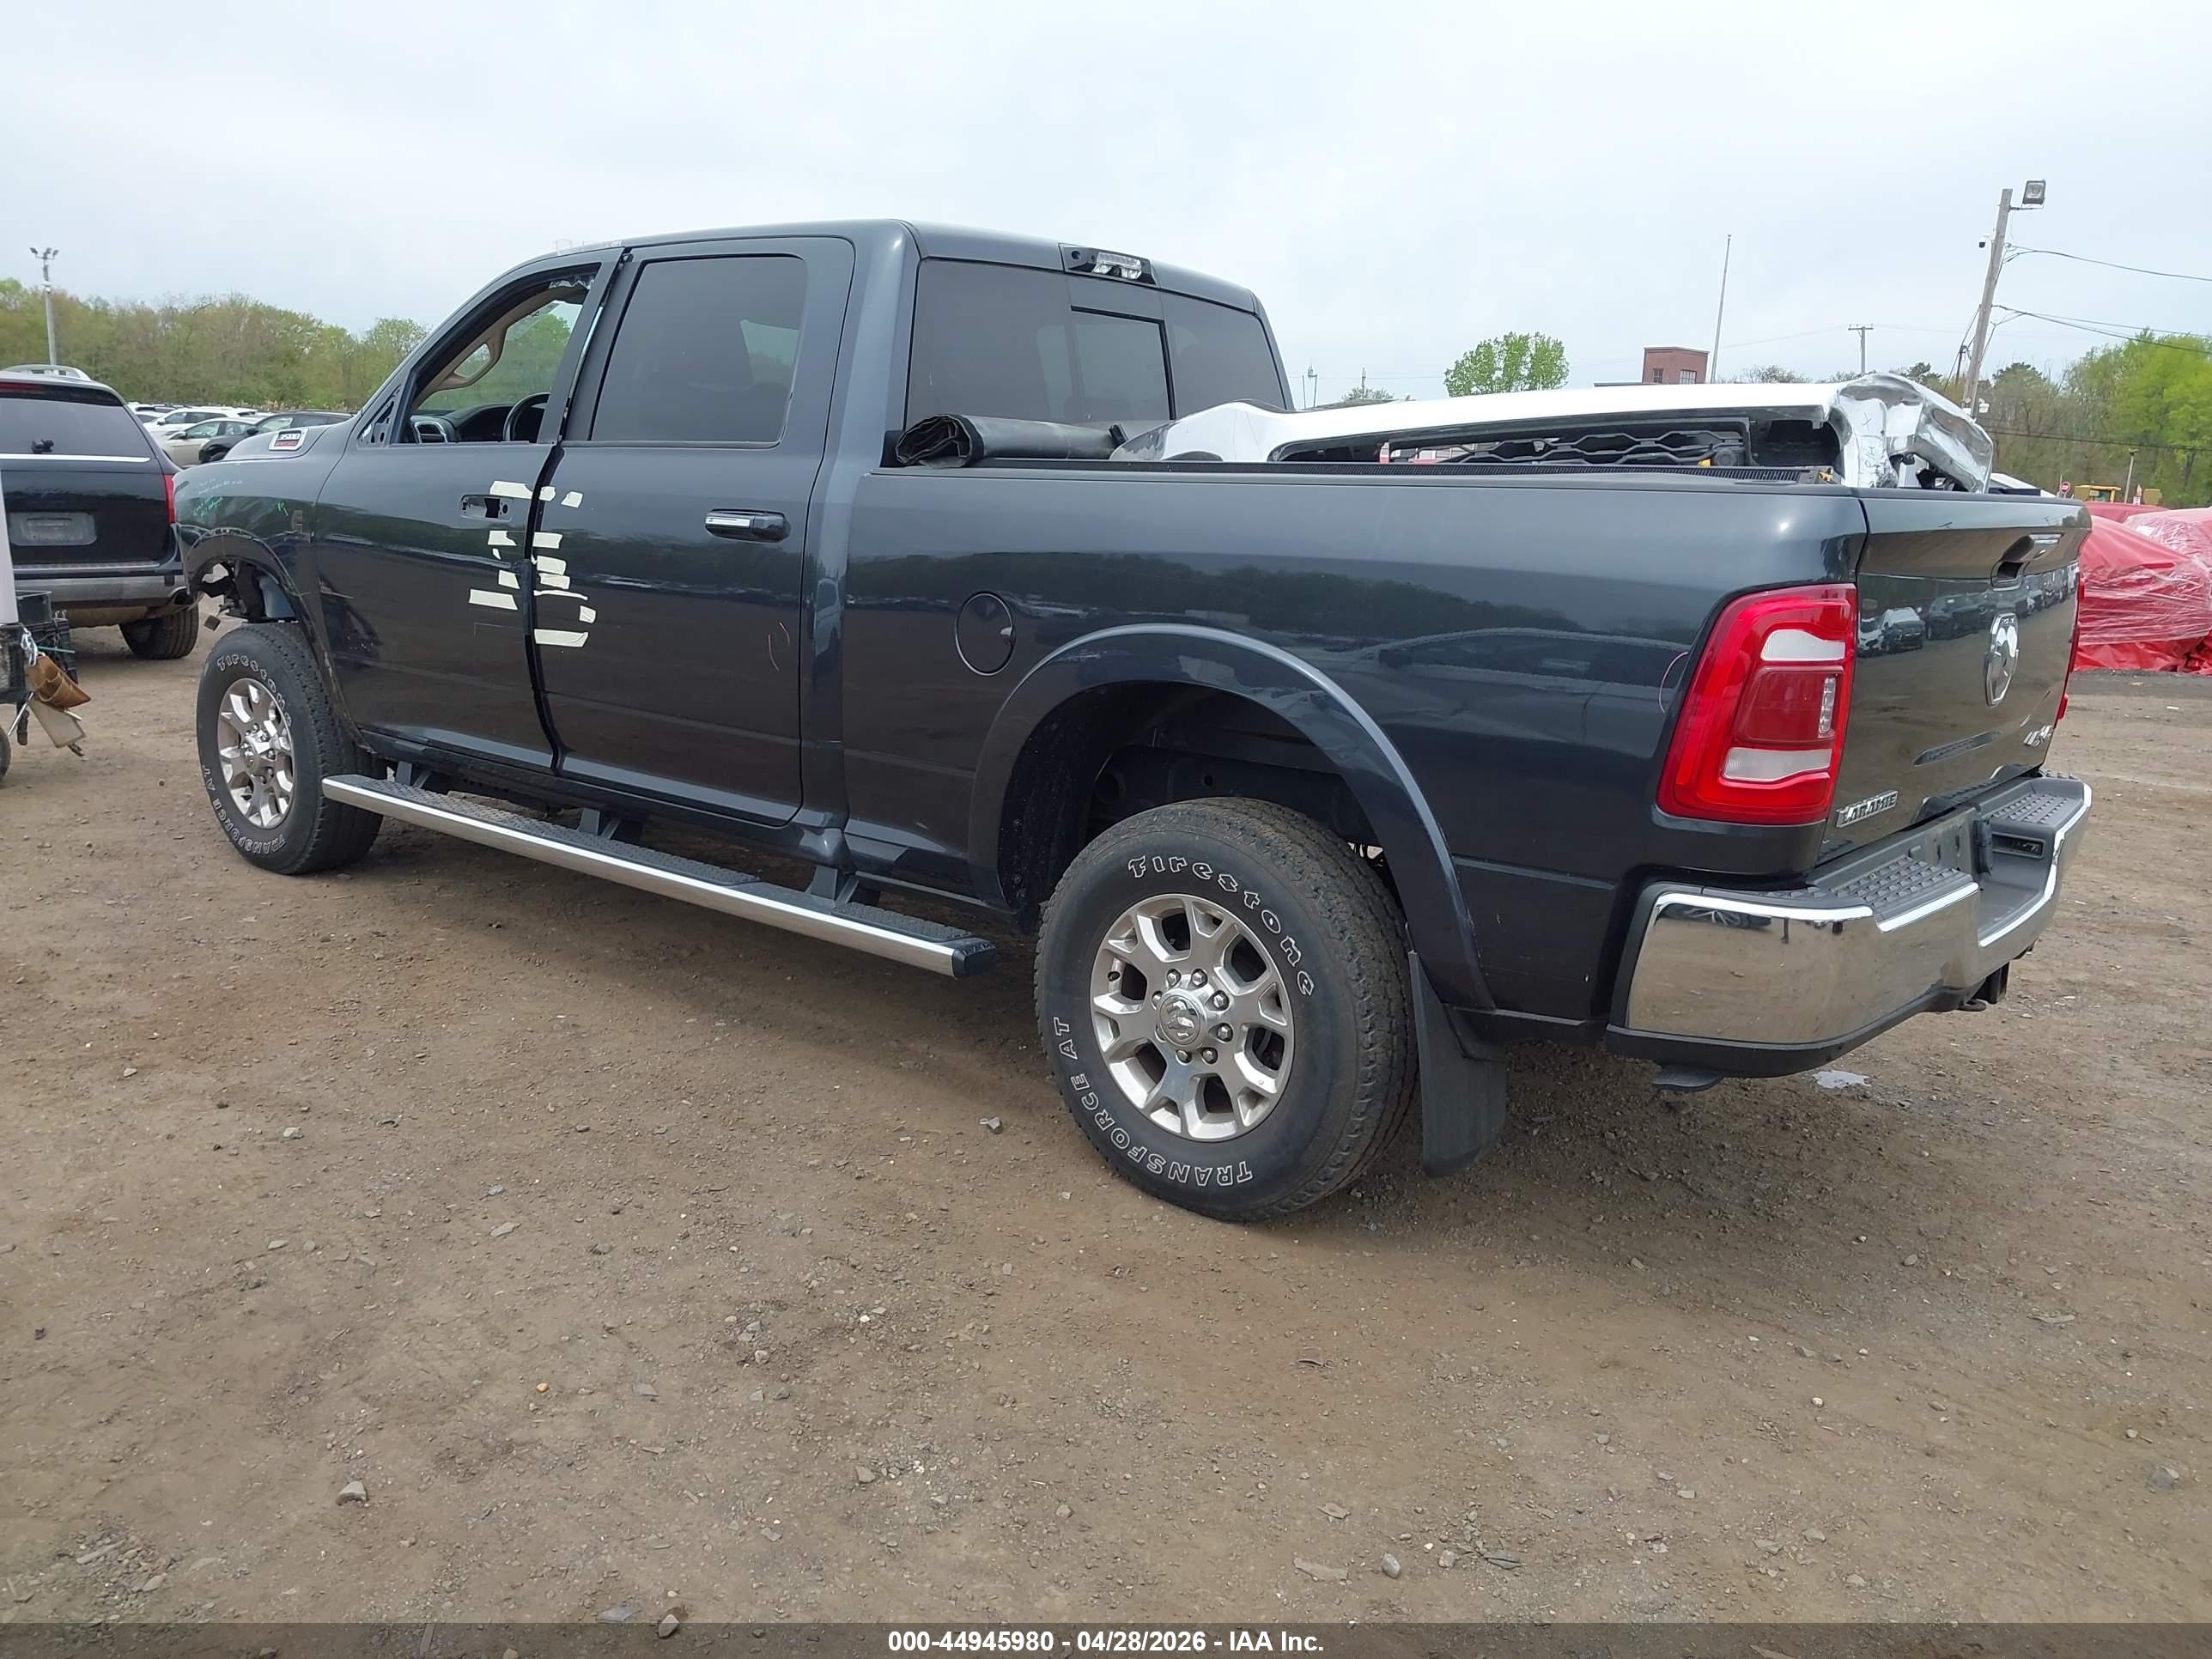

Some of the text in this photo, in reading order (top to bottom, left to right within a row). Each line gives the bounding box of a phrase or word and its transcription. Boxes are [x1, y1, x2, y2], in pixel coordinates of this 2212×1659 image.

[1836, 790, 1899, 828] LARAMIE
[1053, 1017, 1254, 1187] TRANSFORCE AT
